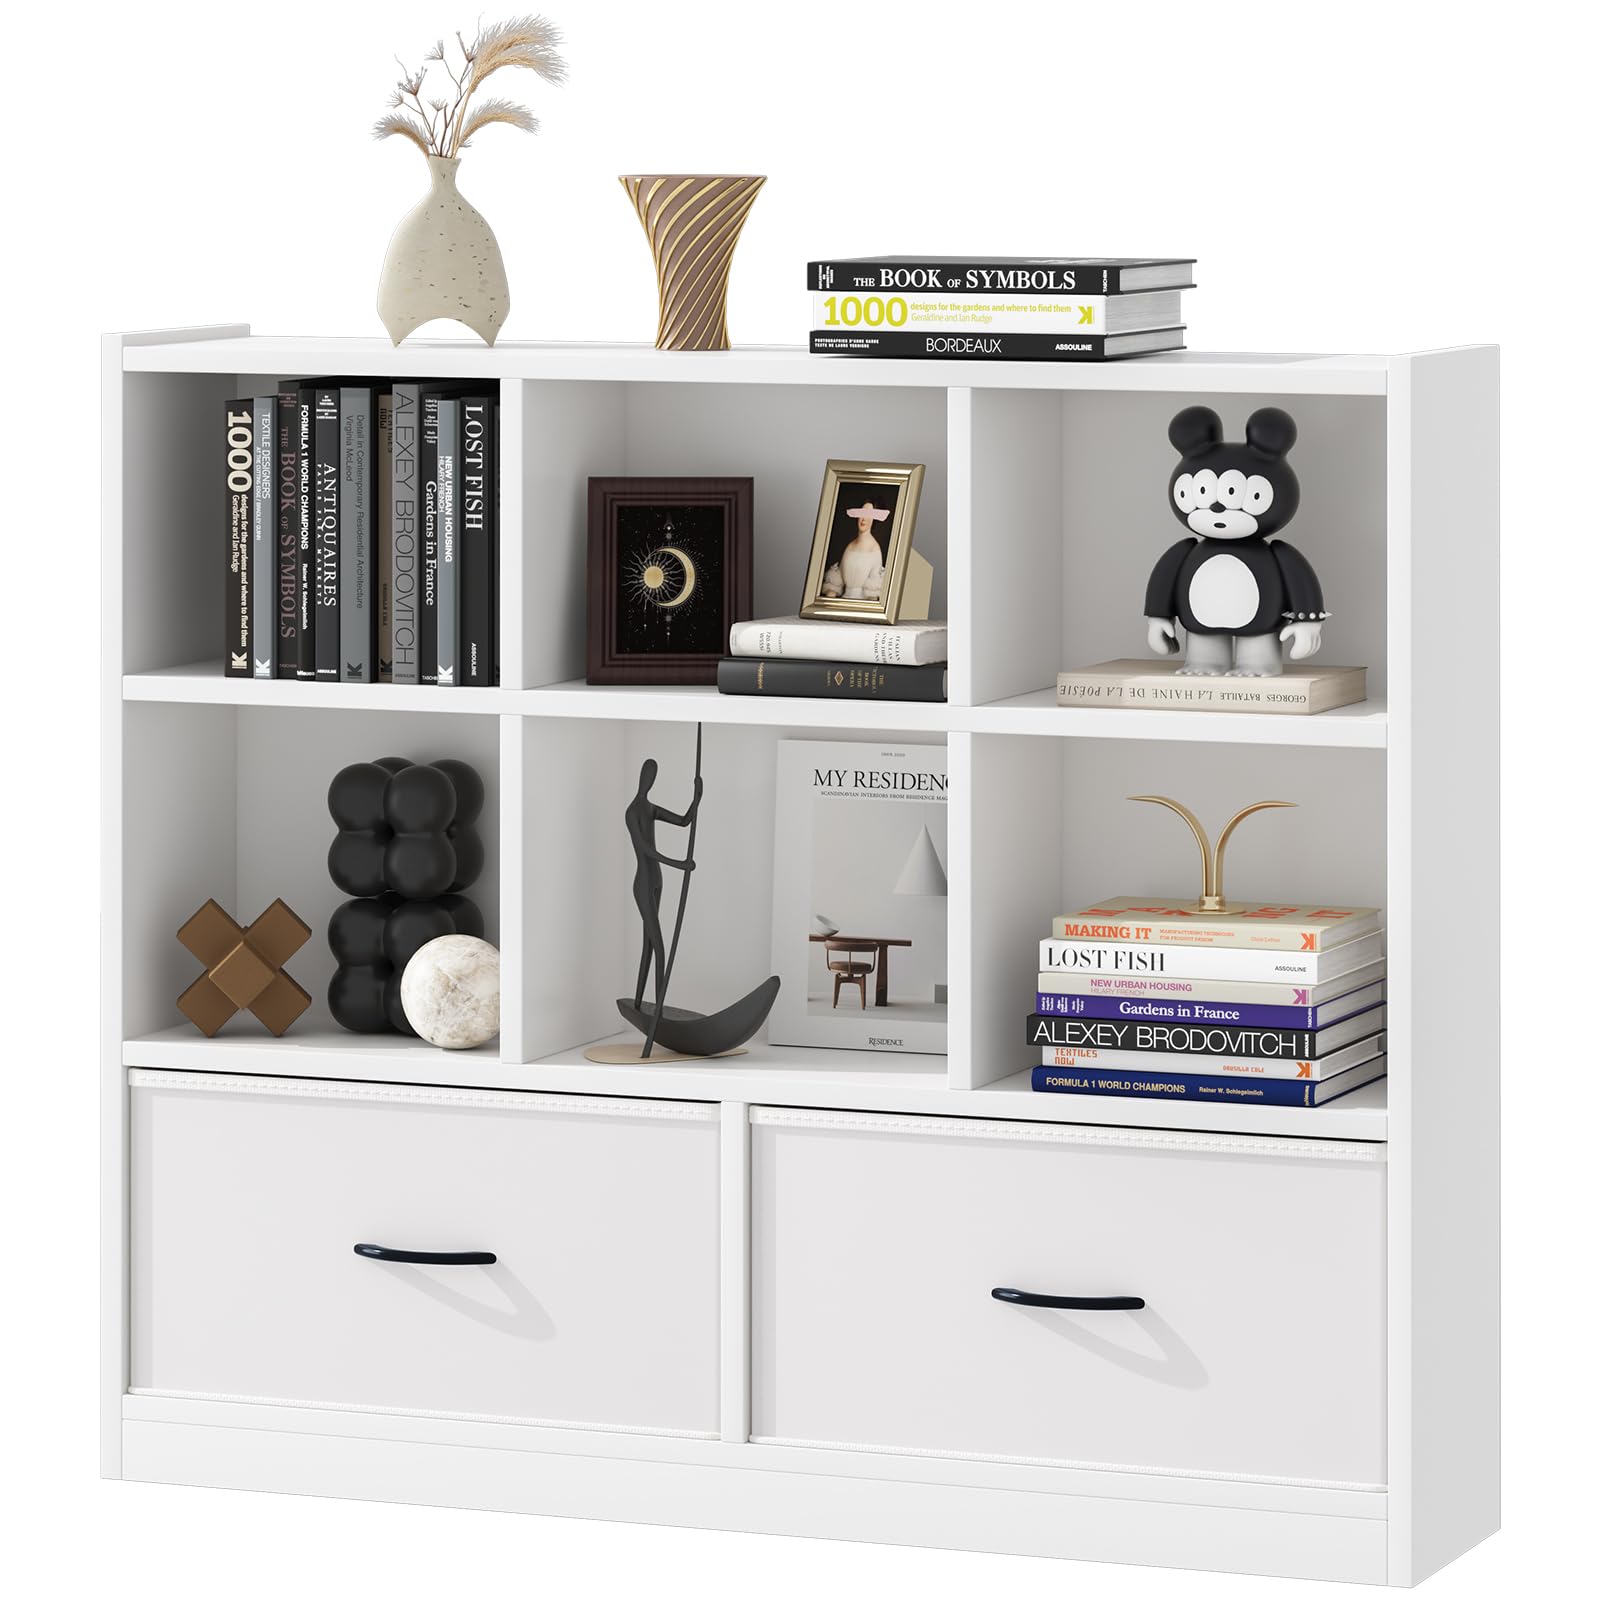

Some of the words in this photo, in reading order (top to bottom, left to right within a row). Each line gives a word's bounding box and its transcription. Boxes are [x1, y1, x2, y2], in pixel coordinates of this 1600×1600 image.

[853, 277, 875, 287] THE
[879, 268, 943, 288] BOOK
[946, 278, 961, 288] OF
[966, 269, 1076, 290] SYMBOLS
[823, 296, 908, 327] 1000
[911, 302, 938, 312] designs
[939, 303, 948, 311] for
[949, 303, 961, 311] the
[962, 304, 990, 313] gardens
[991, 304, 1005, 312] and
[1006, 304, 1028, 312] where
[1050, 305, 1071, 313] them
[911, 313, 943, 321] Geraldine
[971, 315, 992, 324] Rudge
[926, 337, 1002, 353] BORDEAUX
[262, 413, 271, 447] TEXTILE
[281, 427, 289, 447] THE
[301, 405, 309, 449] FORMULA
[344, 415, 354, 446] Virginia
[356, 415, 364, 440] Detail
[465, 405, 483, 468] LOST
[227, 411, 252, 492] 1000
[396, 392, 414, 491] ALEXEY
[261, 451, 271, 499] DESIGNERS
[301, 459, 309, 492] WORLD
[354, 451, 364, 509] Contemporary
[445, 456, 453, 480] NEW
[280, 452, 296, 511] BOOK
[232, 494, 240, 526] Geraldine
[240, 494, 248, 520] designs
[426, 481, 436, 537] Gardens
[445, 481, 453, 514] URBAN
[465, 474, 483, 530] FISH
[281, 516, 288, 529] OF
[300, 495, 309, 550] CHAMPIONS
[321, 463, 337, 607] ANTIQUAIRES
[356, 512, 364, 557] Residential
[426, 541, 437, 554] in
[445, 518, 453, 562] HOUSING
[231, 552, 240, 572] Rudge
[240, 544, 248, 570] gardens
[280, 534, 296, 638] SYMBOLS
[356, 560, 364, 608] Architecture
[396, 501, 414, 664] BRODOVITCH
[426, 559, 437, 605] France
[1106, 687, 1122, 697] LA
[1128, 688, 1144, 698] DE
[1151, 688, 1192, 700] HAINE
[1197, 690, 1212, 700] LA
[1219, 692, 1260, 702] BATAILLE
[1266, 694, 1307, 704] GEORGES
[813, 769, 847, 788] MY
[854, 771, 948, 791] RESIDEN
[1065, 923, 1131, 939] MAKING
[1135, 927, 1152, 940] IT
[1048, 947, 1107, 968] LOST
[1114, 950, 1164, 972] FISH
[1274, 965, 1307, 973] ASSOULINE
[1090, 979, 1112, 988] NEW
[1114, 980, 1146, 989] URBAN
[1149, 982, 1192, 992] HOUSING
[1116, 989, 1144, 997] FRENCH
[1120, 1001, 1174, 1016] Gardens
[1177, 1004, 1190, 1017] in
[1193, 1005, 1240, 1020] France
[868, 1037, 904, 1047] RESIDENCE
[1033, 1020, 1129, 1046] ALEXEY
[1136, 1025, 1296, 1057] BRODOVITCH
[1055, 1048, 1098, 1058] TEXTILES
[1046, 1077, 1089, 1088] FORMULA
[1091, 1080, 1095, 1088] 1
[1098, 1080, 1131, 1090] WORLD
[1132, 1082, 1186, 1094] CHAMPIONS
